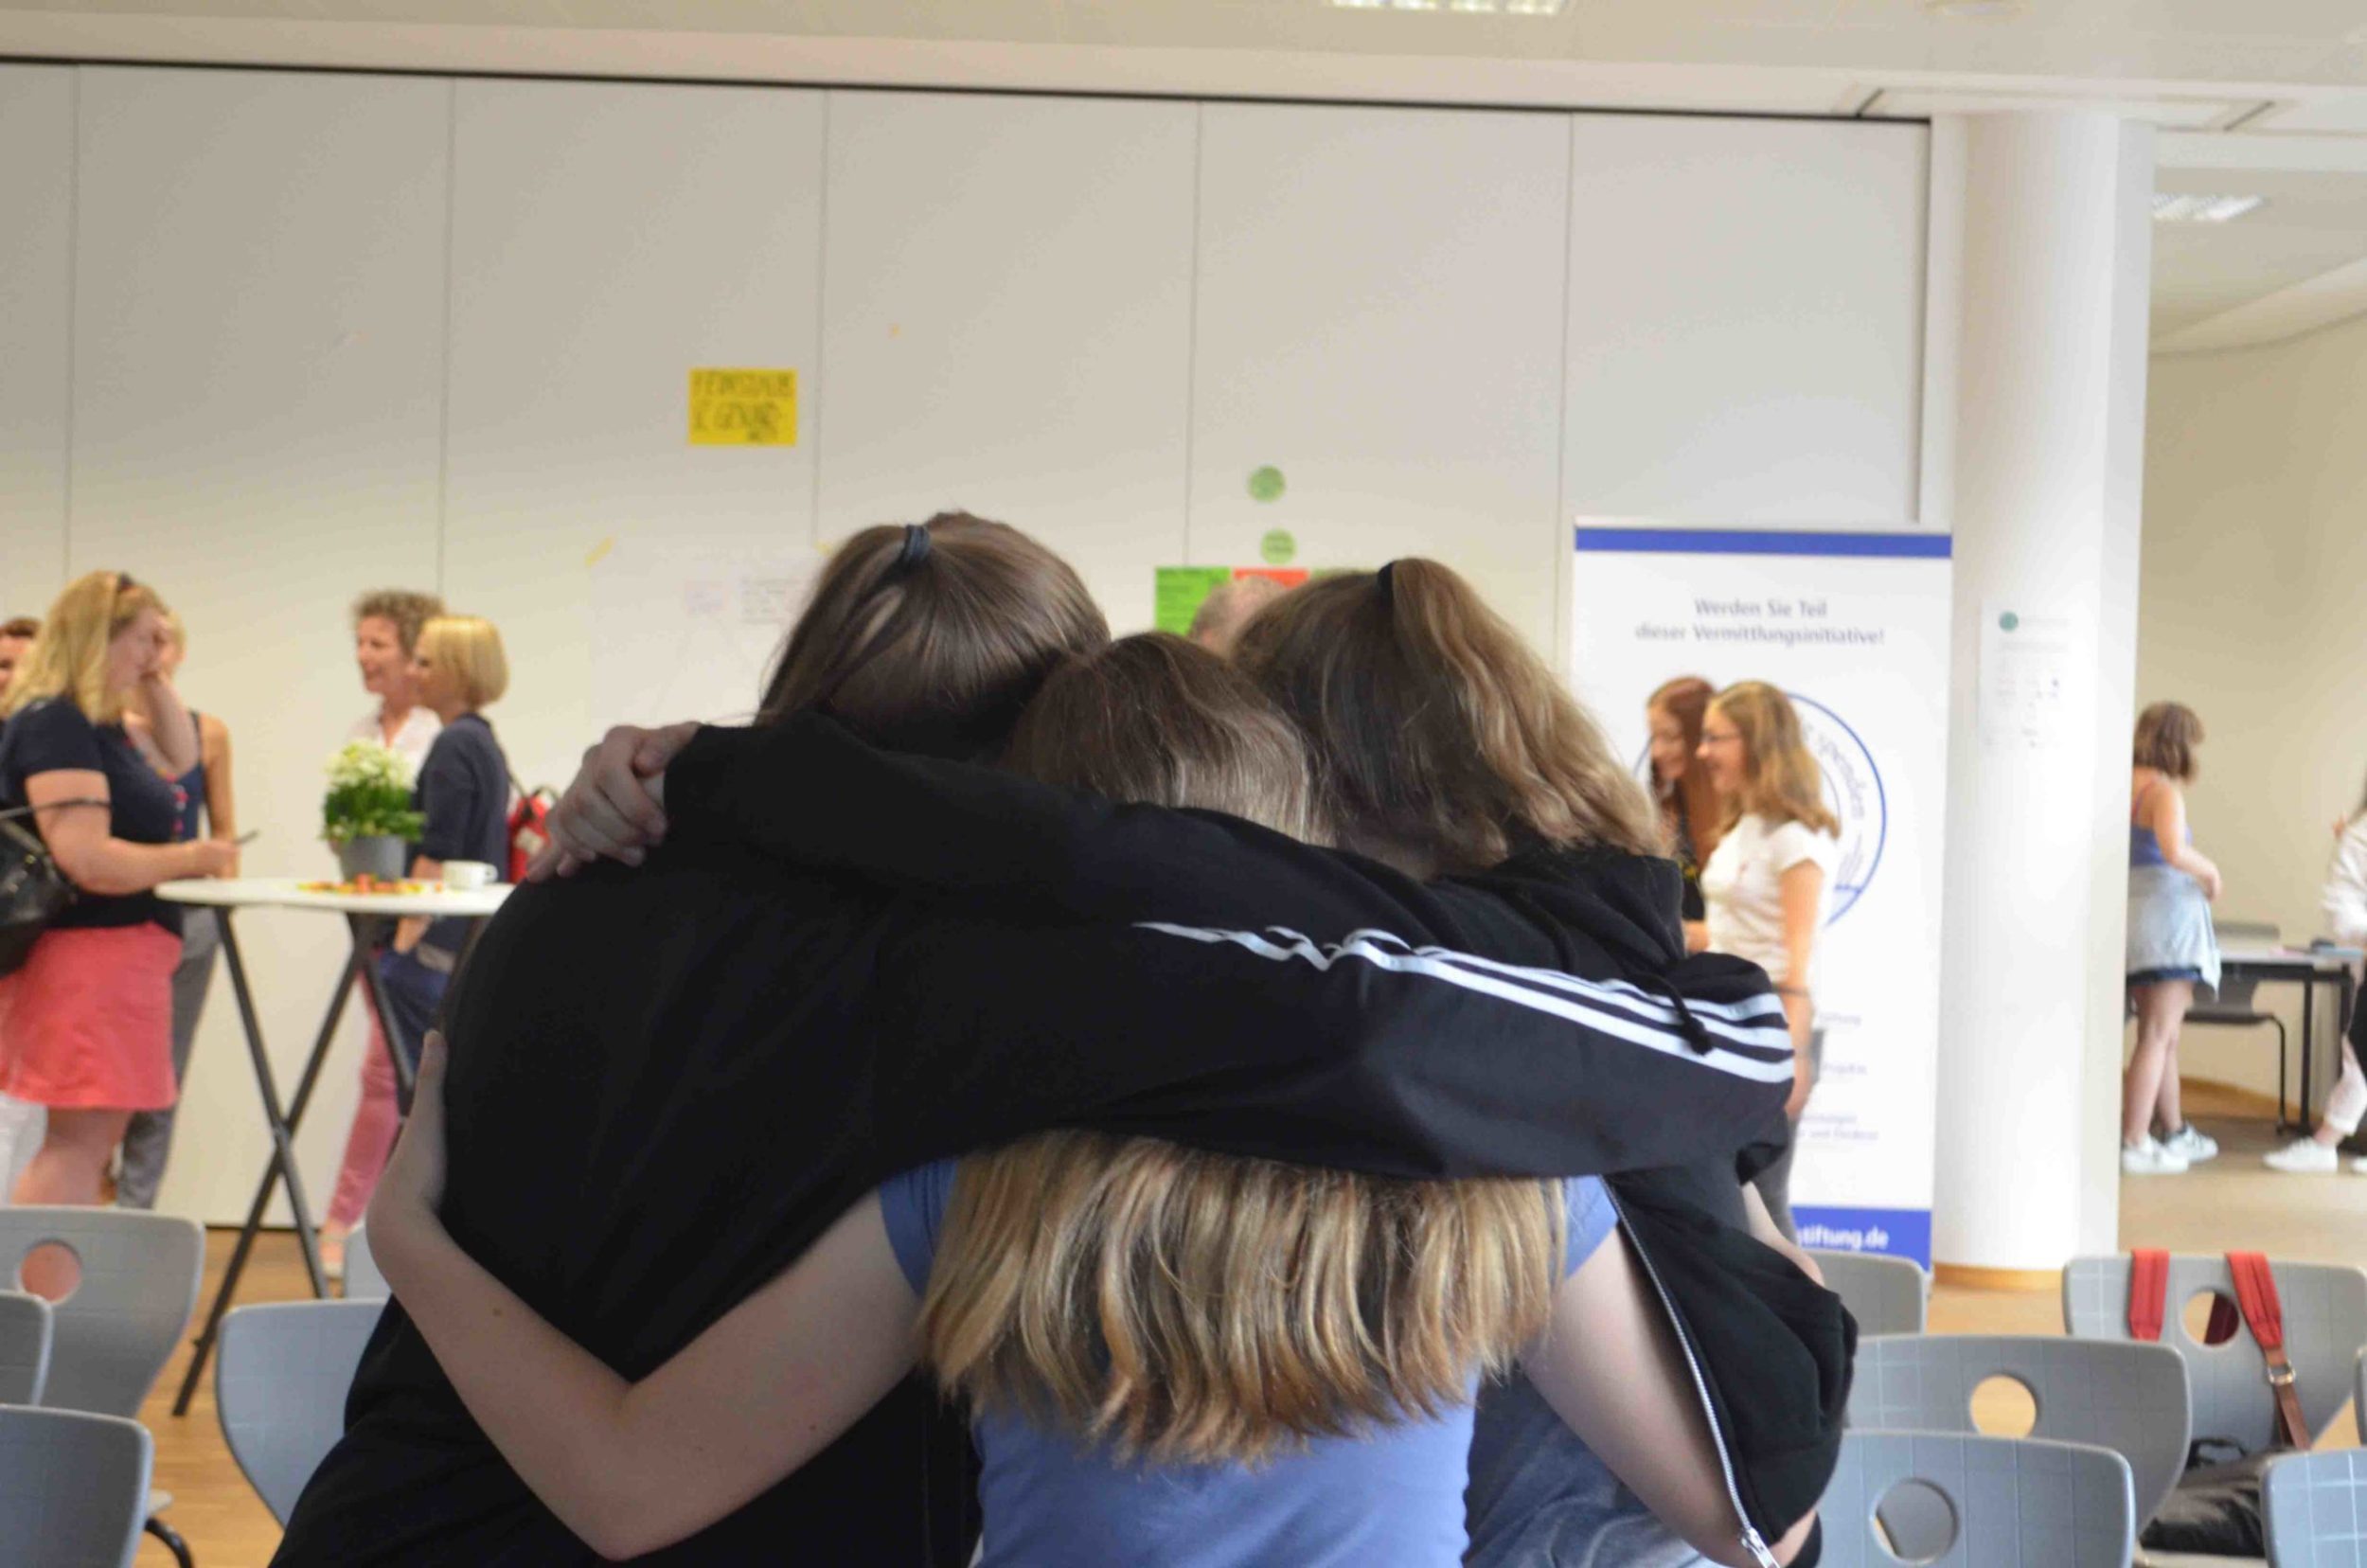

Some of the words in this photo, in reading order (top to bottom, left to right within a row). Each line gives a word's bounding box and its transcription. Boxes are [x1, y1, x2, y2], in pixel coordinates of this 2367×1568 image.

[1694, 598, 1761, 617] Werden
[1767, 599, 1792, 618] Sie
[1798, 599, 1827, 618] Teil
[1635, 622, 1685, 640] dieser
[1693, 624, 1885, 648] Vermittlungsinitiative!
